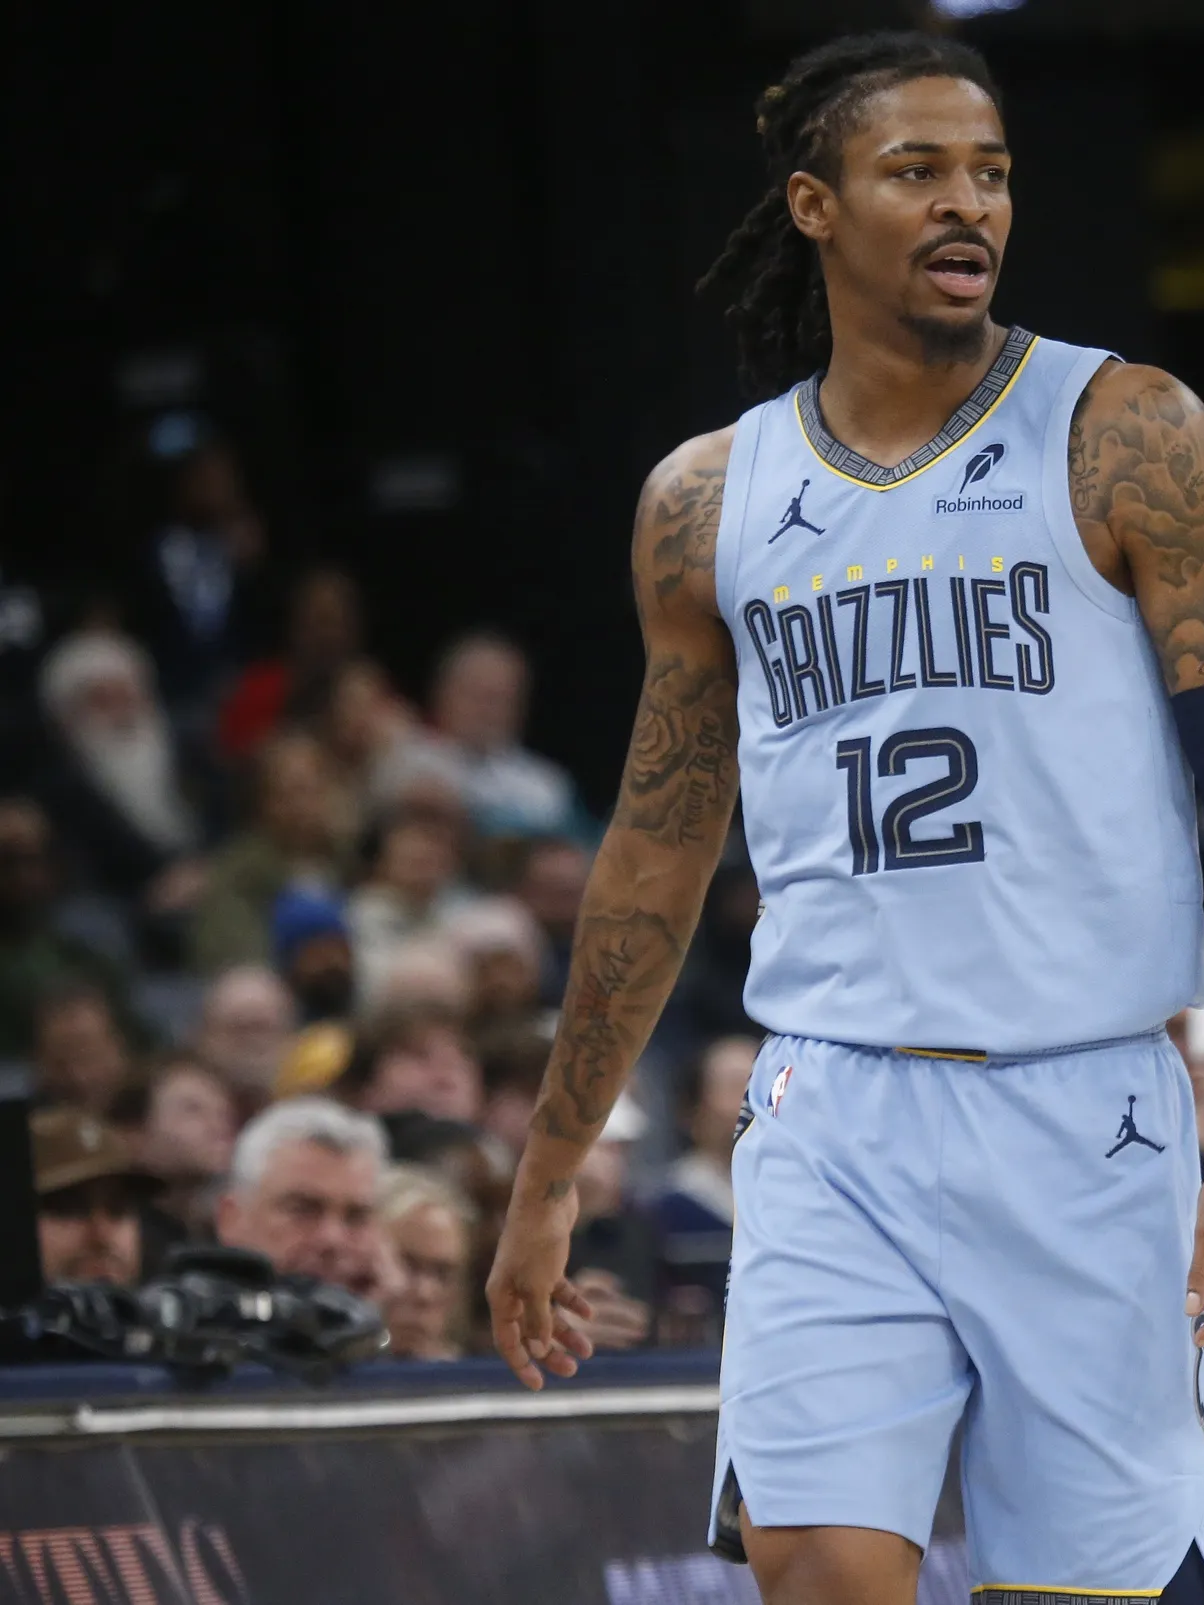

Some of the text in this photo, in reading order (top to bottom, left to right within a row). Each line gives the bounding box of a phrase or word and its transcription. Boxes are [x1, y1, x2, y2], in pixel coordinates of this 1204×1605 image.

[936, 494, 1023, 514] Robinhood
[772, 553, 1004, 605] MEMPHIS
[743, 560, 1056, 729] GRIZZLIES
[836, 726, 985, 877] 12
